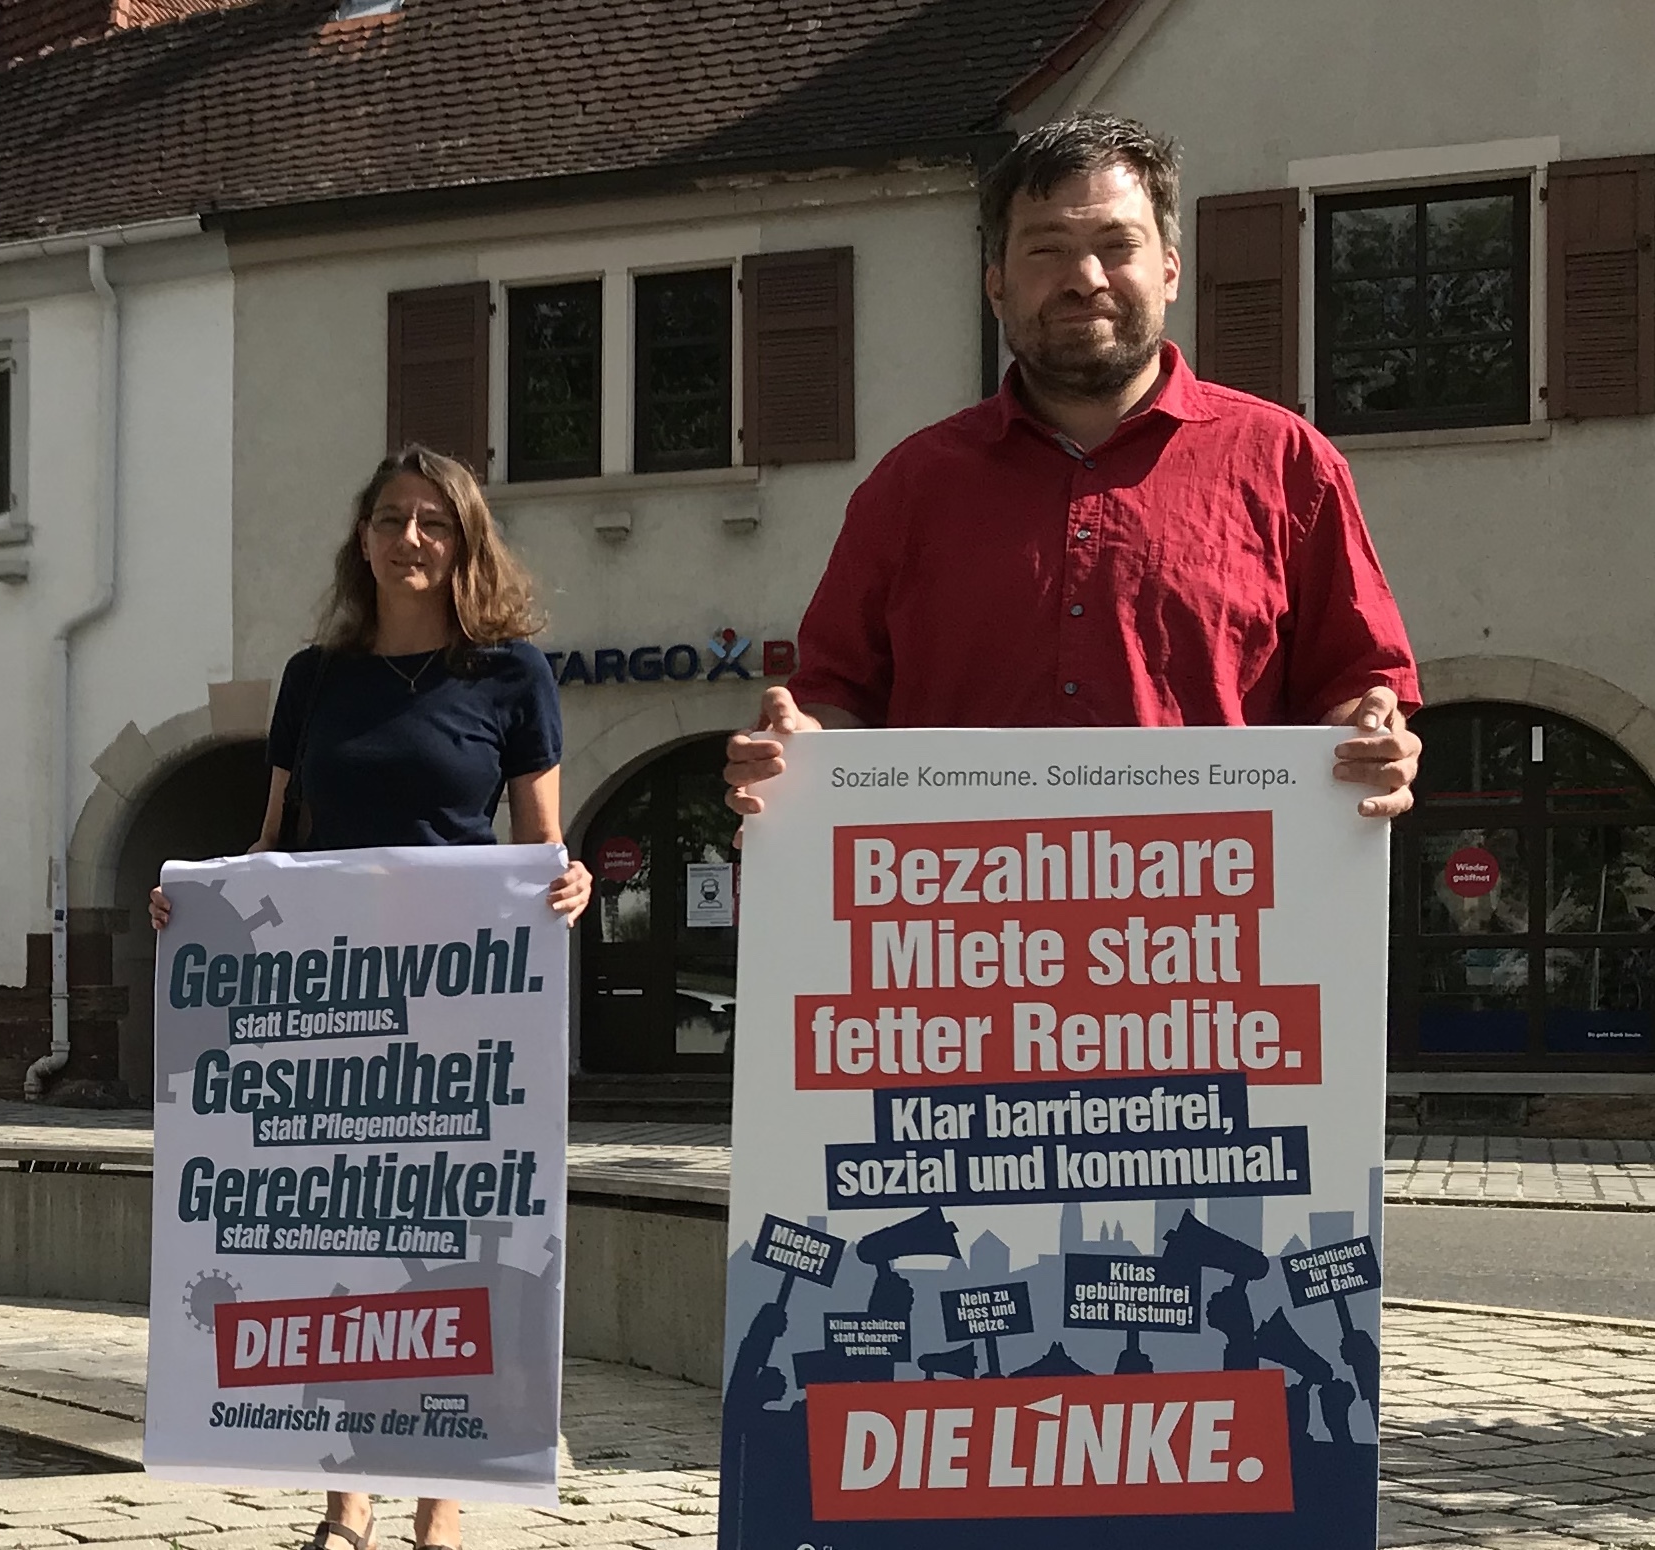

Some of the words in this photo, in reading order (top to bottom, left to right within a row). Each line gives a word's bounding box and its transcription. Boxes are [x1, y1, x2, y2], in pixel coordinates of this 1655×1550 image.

[832, 766, 909, 788] Soziale
[917, 765, 1038, 787] Kommune.
[1047, 764, 1199, 787] Solidarisches
[1209, 764, 1297, 791] Europa.
[853, 829, 1255, 907] Bezahlbare
[1452, 873, 1490, 883] geöffnet
[1455, 863, 1488, 871] Wieder
[871, 919, 1065, 990] Miete
[1088, 913, 1242, 986] statt
[169, 926, 544, 1009] Gemeinwohl.
[235, 1011, 281, 1039] statt
[287, 1007, 399, 1037] Egoismus.
[811, 1005, 992, 1075] fetter
[1012, 999, 1302, 1073] Rendite.
[192, 1039, 525, 1115] Gesundheit.
[259, 1114, 307, 1140] statt
[311, 1109, 483, 1142] Pflegenotstand.
[892, 1096, 975, 1142] Klar
[986, 1084, 1234, 1139] barrierefrei,
[836, 1149, 957, 1196] sozial
[969, 1144, 1046, 1192] und
[1057, 1136, 1298, 1191] kommunal.
[178, 1149, 546, 1223] Gerechtigkeit.
[222, 1223, 270, 1249] statt
[273, 1224, 380, 1251] schlechte
[385, 1225, 459, 1254] Löhne.
[771, 1224, 831, 1259] Mieten
[765, 1244, 825, 1276] runter!
[1110, 1262, 1156, 1282] Kitas
[1289, 1242, 1367, 1272] Sozialticket
[1309, 1267, 1327, 1282] für
[1330, 1262, 1355, 1277] Bus
[959, 1291, 990, 1307] Nein
[994, 1290, 1009, 1302] zu
[1075, 1281, 1190, 1304] gebührenfrei
[1304, 1281, 1330, 1298] und
[1331, 1274, 1368, 1292] Bahn.
[829, 1320, 858, 1331] Klima
[861, 1319, 906, 1331] schützen
[957, 1306, 988, 1321] Hass
[991, 1301, 1016, 1316] und
[968, 1317, 1009, 1334] Hetze.
[1069, 1302, 1110, 1320] statt
[1114, 1303, 1193, 1326] Rüstung!
[234, 1315, 311, 1370] DIE
[833, 1332, 855, 1343] statt
[858, 1332, 902, 1343] Konzern-
[845, 1345, 891, 1357] gewinne.
[423, 1396, 466, 1411] Corona
[209, 1401, 329, 1432] Solidarisch
[335, 1411, 374, 1434] aus
[381, 1408, 419, 1437] der
[422, 1410, 488, 1441] Krise.
[840, 1408, 974, 1490] DIE
